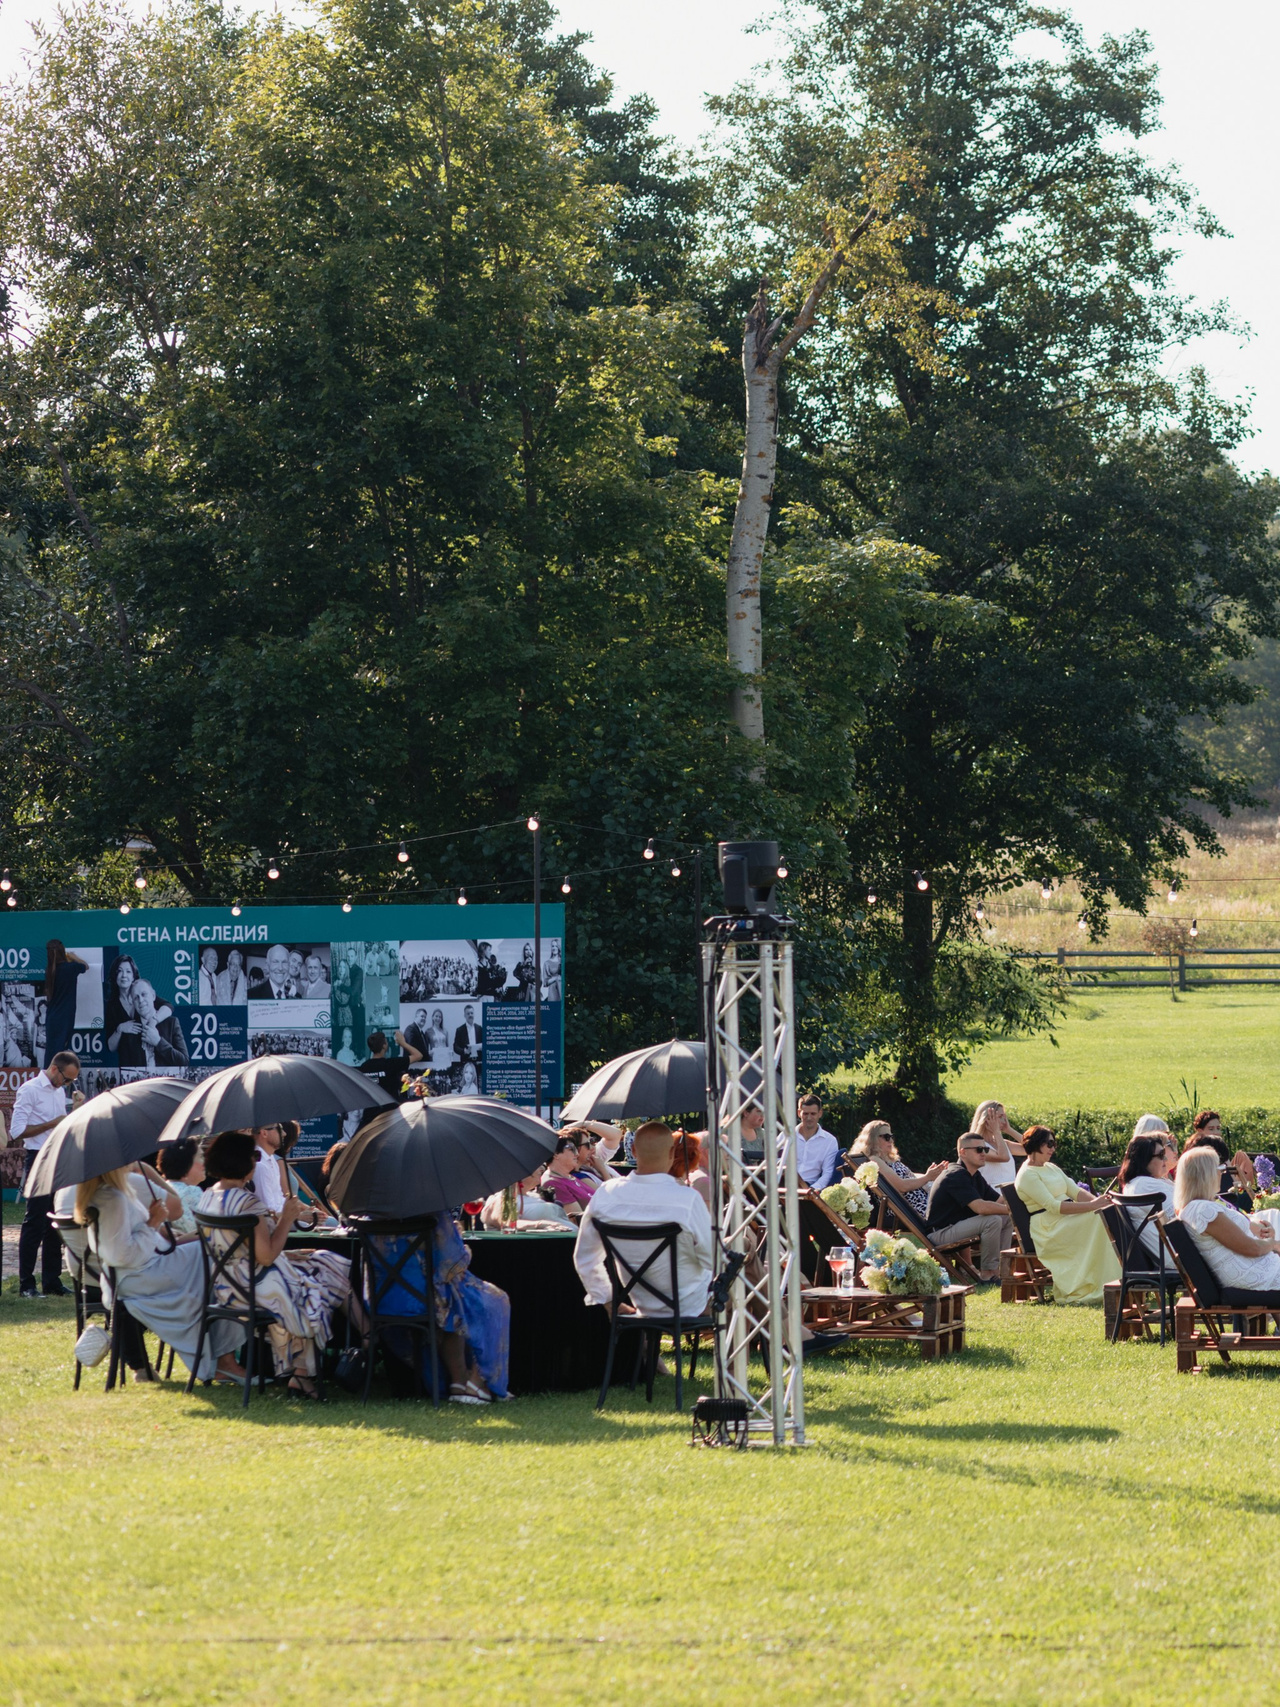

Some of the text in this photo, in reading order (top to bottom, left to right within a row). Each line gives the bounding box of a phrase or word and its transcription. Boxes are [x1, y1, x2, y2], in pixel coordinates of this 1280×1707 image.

[117, 925, 268, 943] СТЕНА НАСЛЕДИЯ
[174, 949, 191, 1005] 2019
[190, 1012, 217, 1036] 20
[71, 1033, 103, 1053] 016
[191, 1037, 218, 1060] 20
